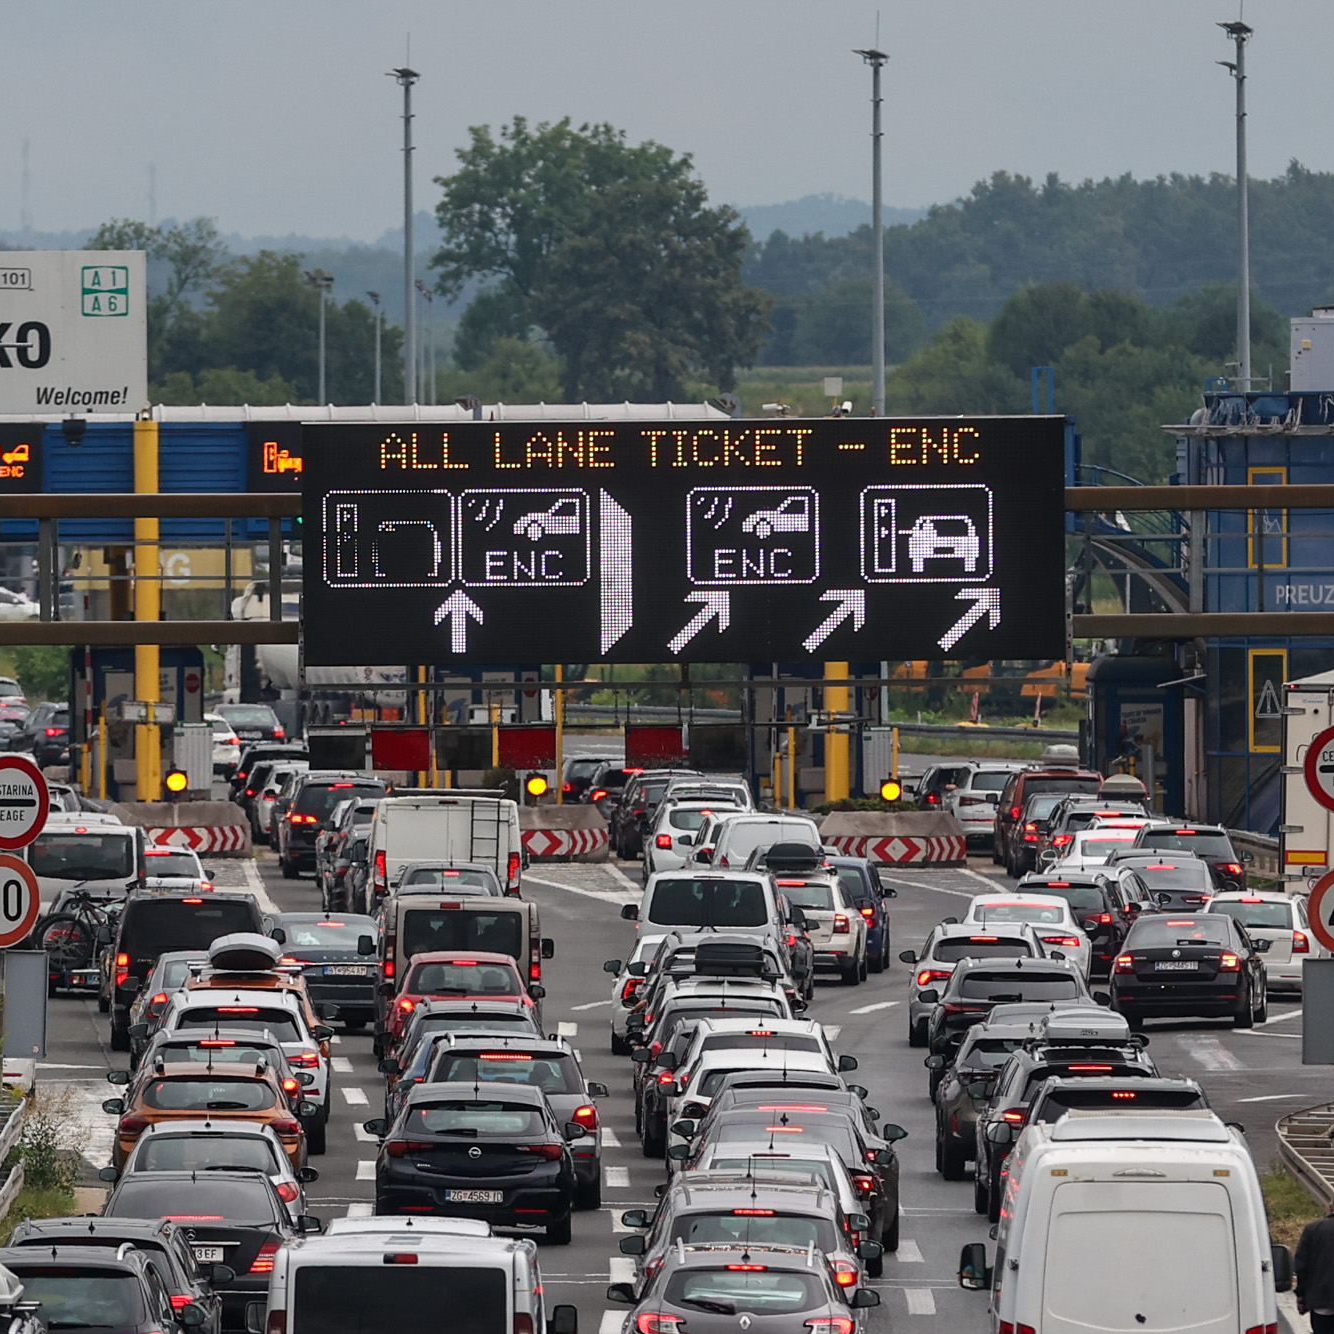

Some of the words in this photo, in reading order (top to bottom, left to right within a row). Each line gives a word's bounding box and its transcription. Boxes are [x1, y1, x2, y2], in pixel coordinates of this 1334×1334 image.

[1, 273, 27, 285] 101
[35, 387, 128, 405] Welcome!
[381, 433, 469, 468] ALL
[495, 432, 615, 468] LANE
[641, 430, 812, 466] TICKET
[891, 428, 980, 464] ENC
[486, 551, 564, 579] ENC
[715, 549, 793, 578] ENC
